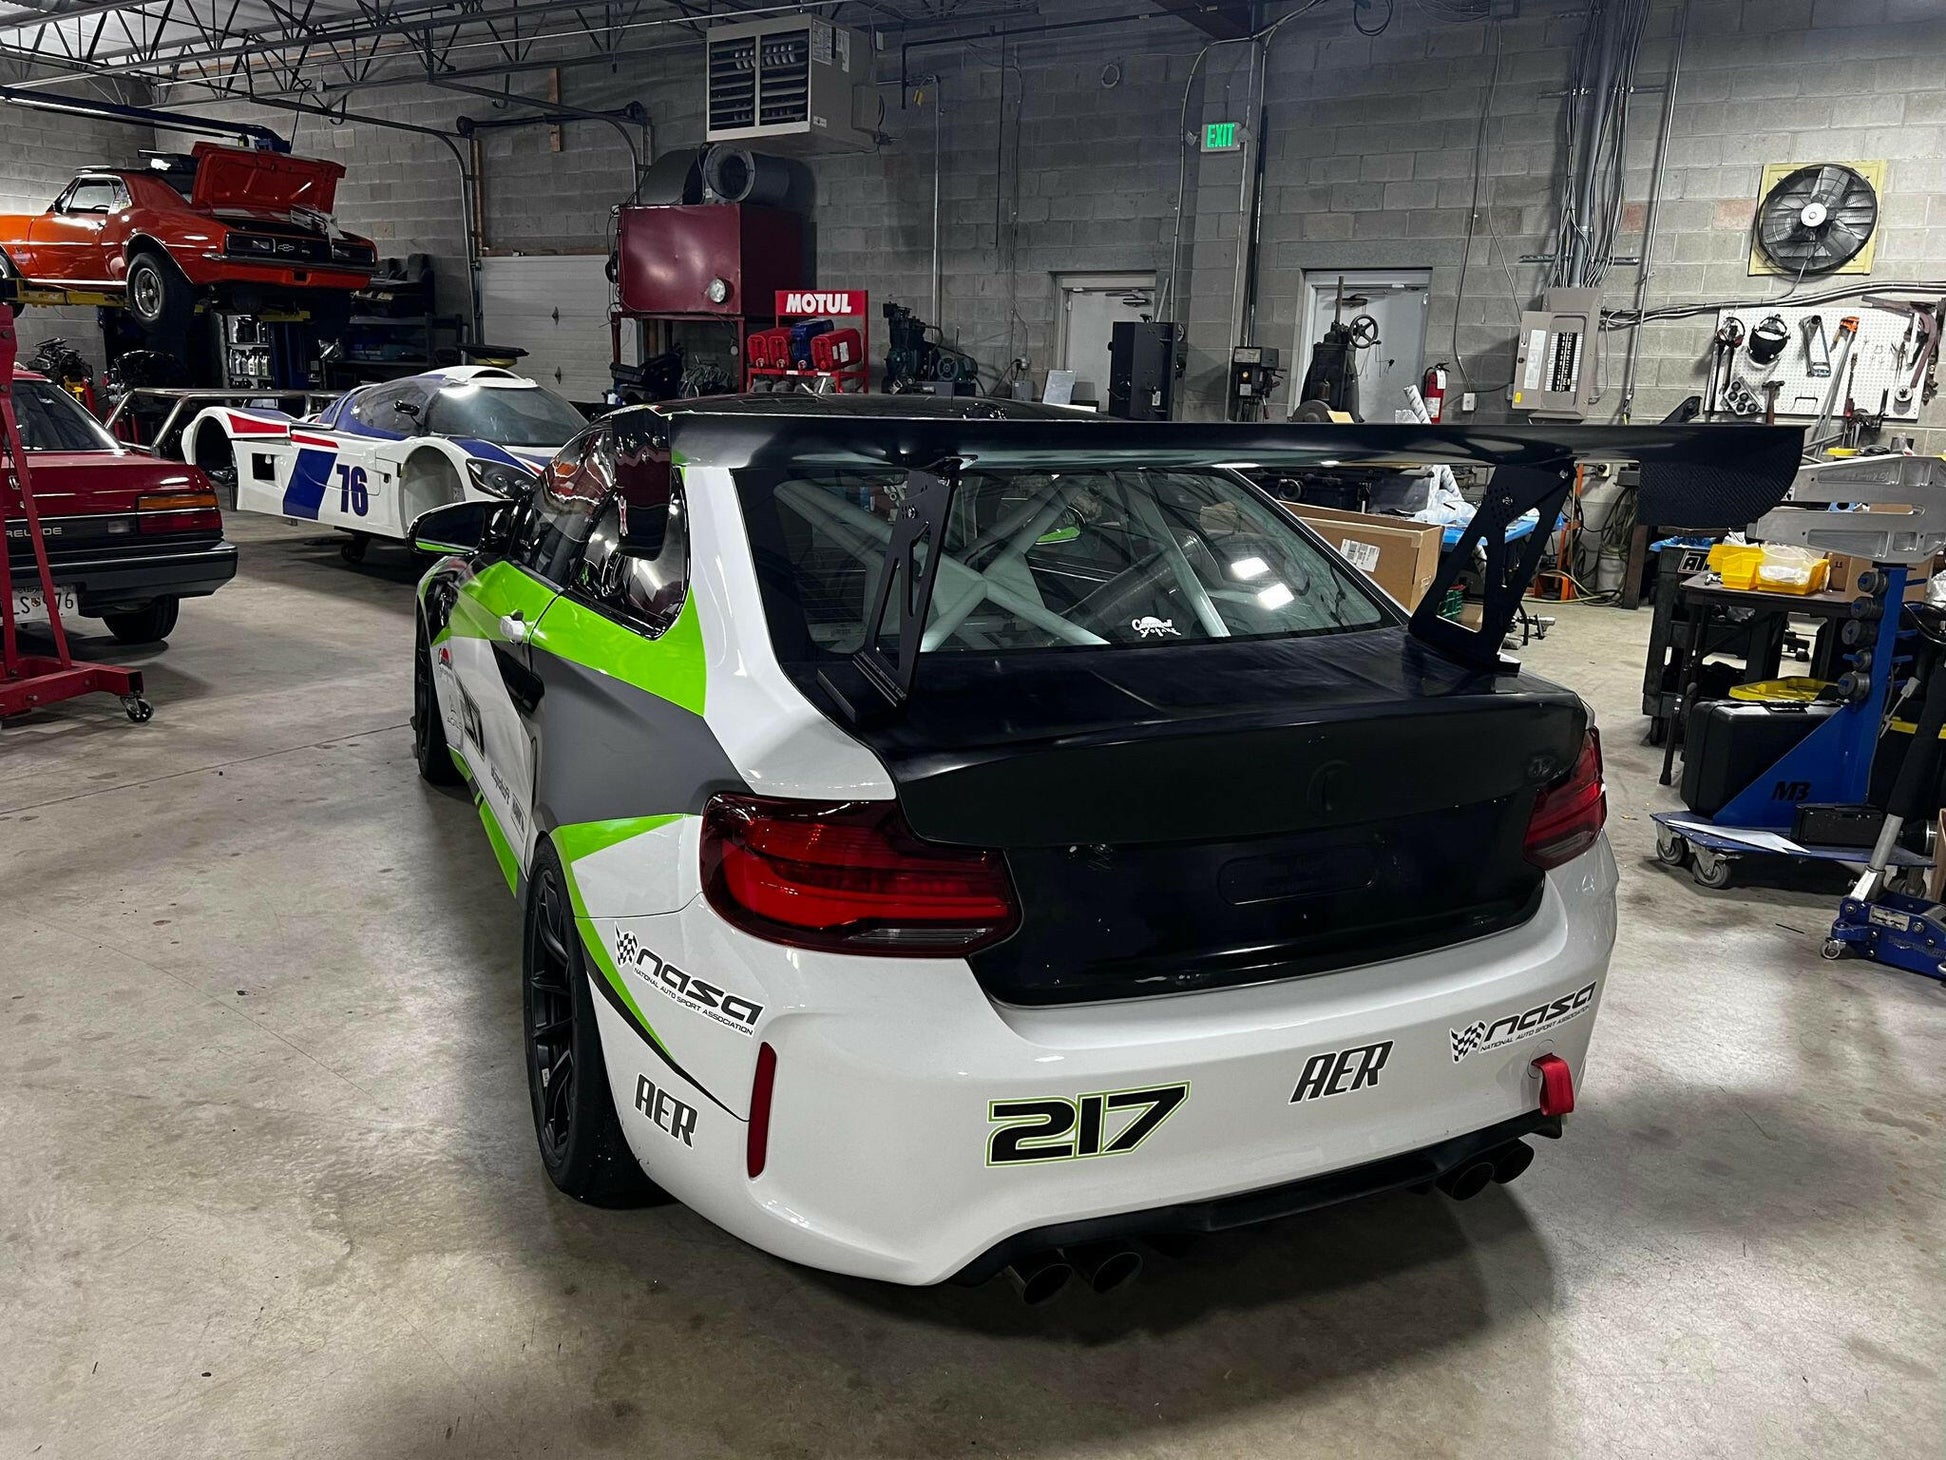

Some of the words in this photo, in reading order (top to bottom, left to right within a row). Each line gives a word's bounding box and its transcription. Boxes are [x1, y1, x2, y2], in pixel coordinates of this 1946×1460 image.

[1207, 123, 1235, 148] EXIT
[785, 293, 852, 314] MOTUL
[336, 463, 369, 517] 76
[633, 967, 660, 989] NATIONAL
[660, 987, 677, 999] AUTO
[676, 995, 702, 1012] SPORT
[702, 1009, 753, 1036] ASSOCIATION
[635, 948, 764, 1026] nasa
[1483, 980, 1597, 1043] nasa
[1481, 1037, 1513, 1051] NATIONAL
[1515, 1030, 1535, 1041] AUTO
[1534, 1021, 1557, 1035] SPORT
[1288, 1040, 1394, 1105] AER
[634, 1072, 698, 1149] AER
[986, 1081, 1191, 1167] 217
